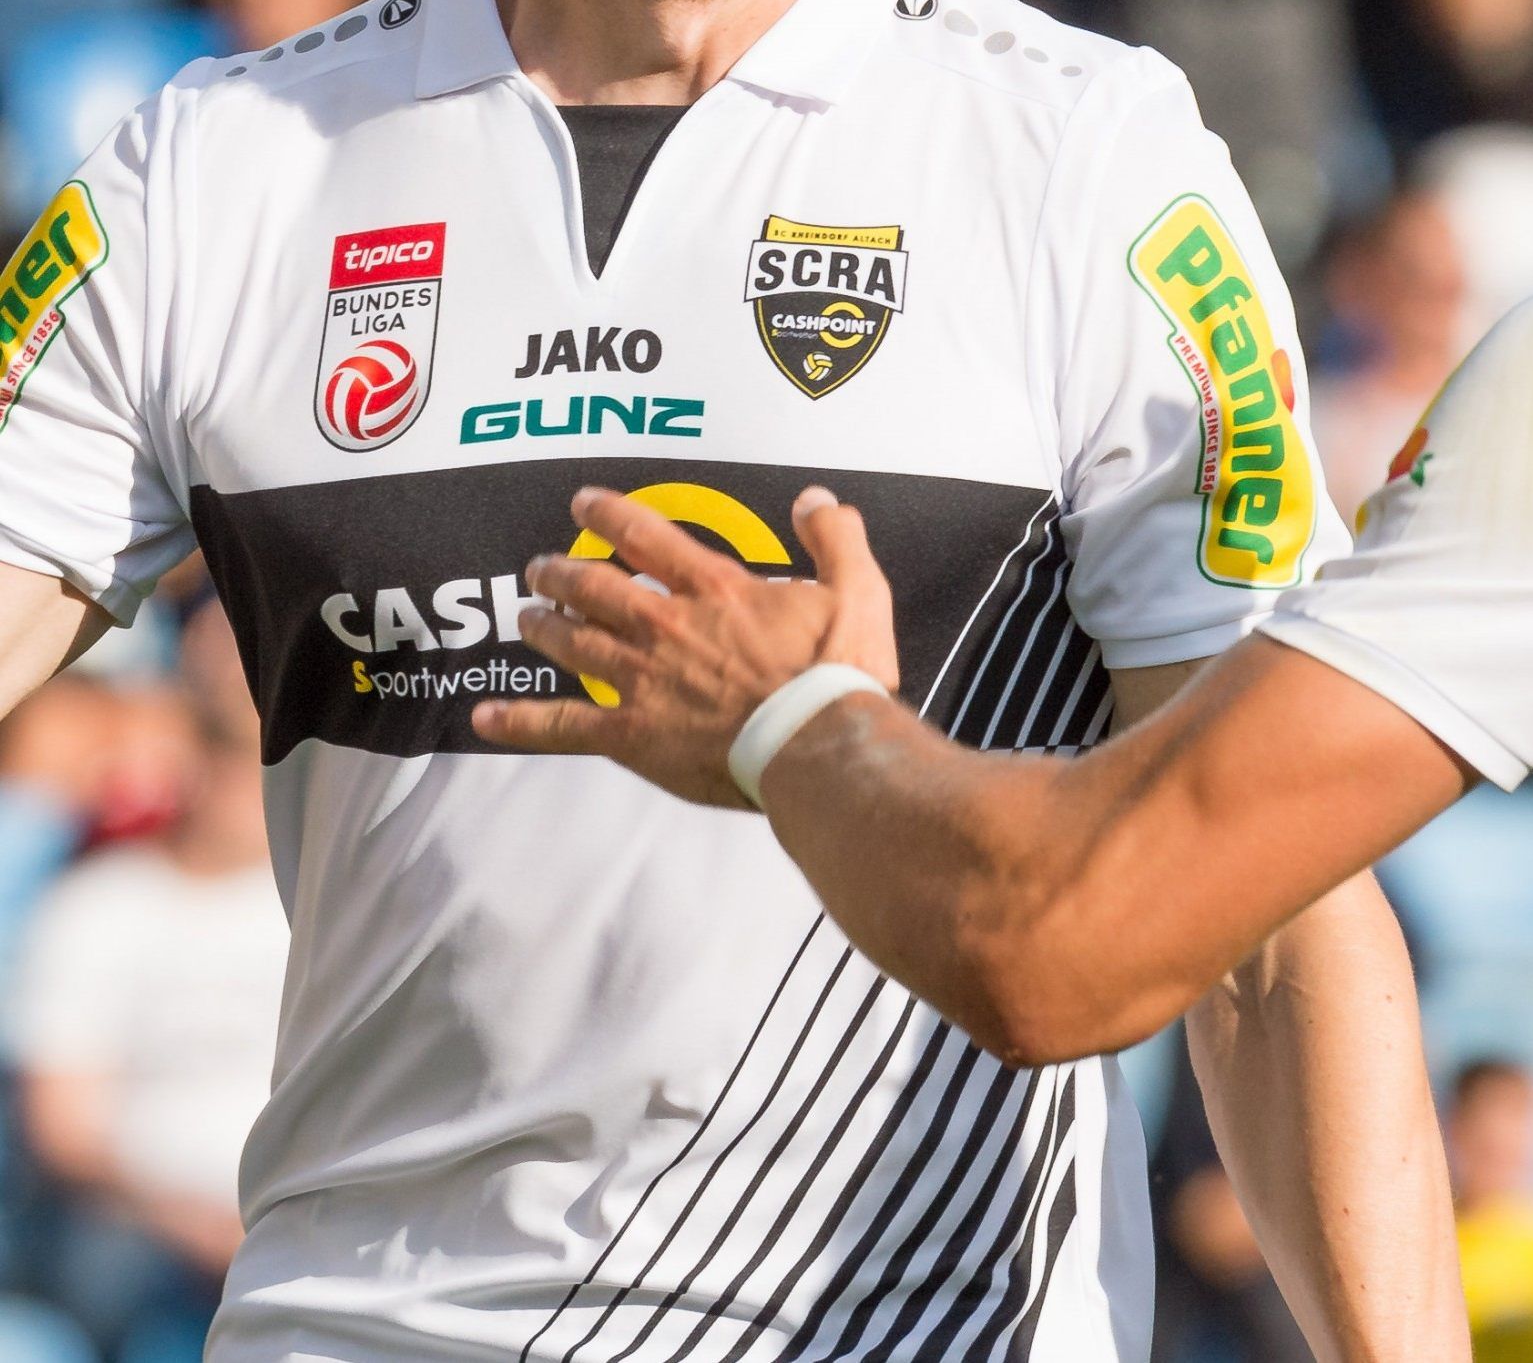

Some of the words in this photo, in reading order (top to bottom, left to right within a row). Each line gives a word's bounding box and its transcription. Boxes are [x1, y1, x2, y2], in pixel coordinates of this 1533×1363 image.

[0, 211, 77, 346] ner
[344, 240, 434, 272] tipico
[754, 249, 896, 303] SCRA
[333, 288, 432, 316] BUNDES
[351, 313, 405, 336] LIGA
[771, 313, 877, 335] CASHPOINT
[515, 326, 662, 379] JAKO
[1156, 224, 1284, 565] Pfanner
[460, 395, 705, 445] GUNZ
[1204, 408, 1218, 455] SINCE
[352, 658, 557, 700] Sportwetten
